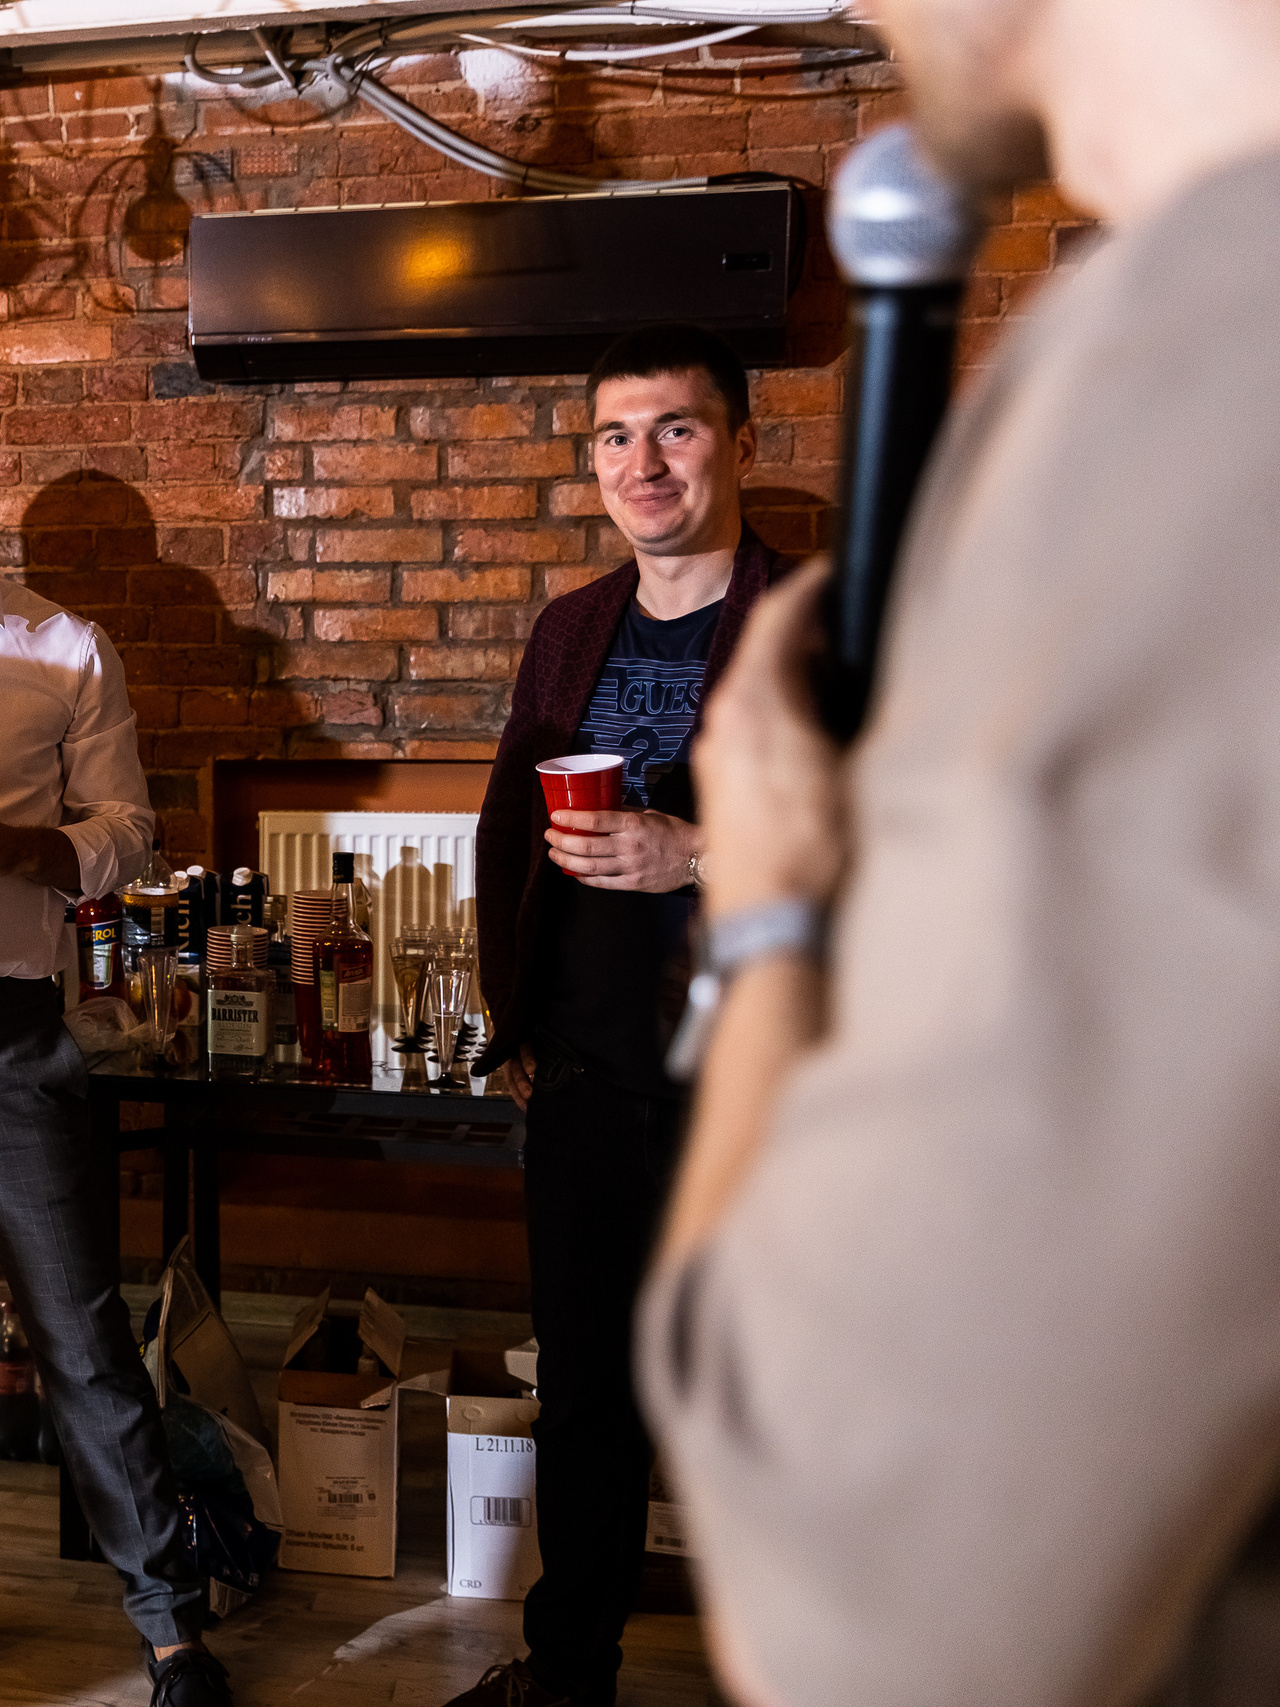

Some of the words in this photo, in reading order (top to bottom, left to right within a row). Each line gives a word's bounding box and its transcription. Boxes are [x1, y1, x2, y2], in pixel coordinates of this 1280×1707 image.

[211, 1007, 259, 1023] BARRISTER
[475, 1437, 484, 1451] L
[487, 1437, 533, 1453] 21.11.18
[459, 1579, 482, 1589] CRD
